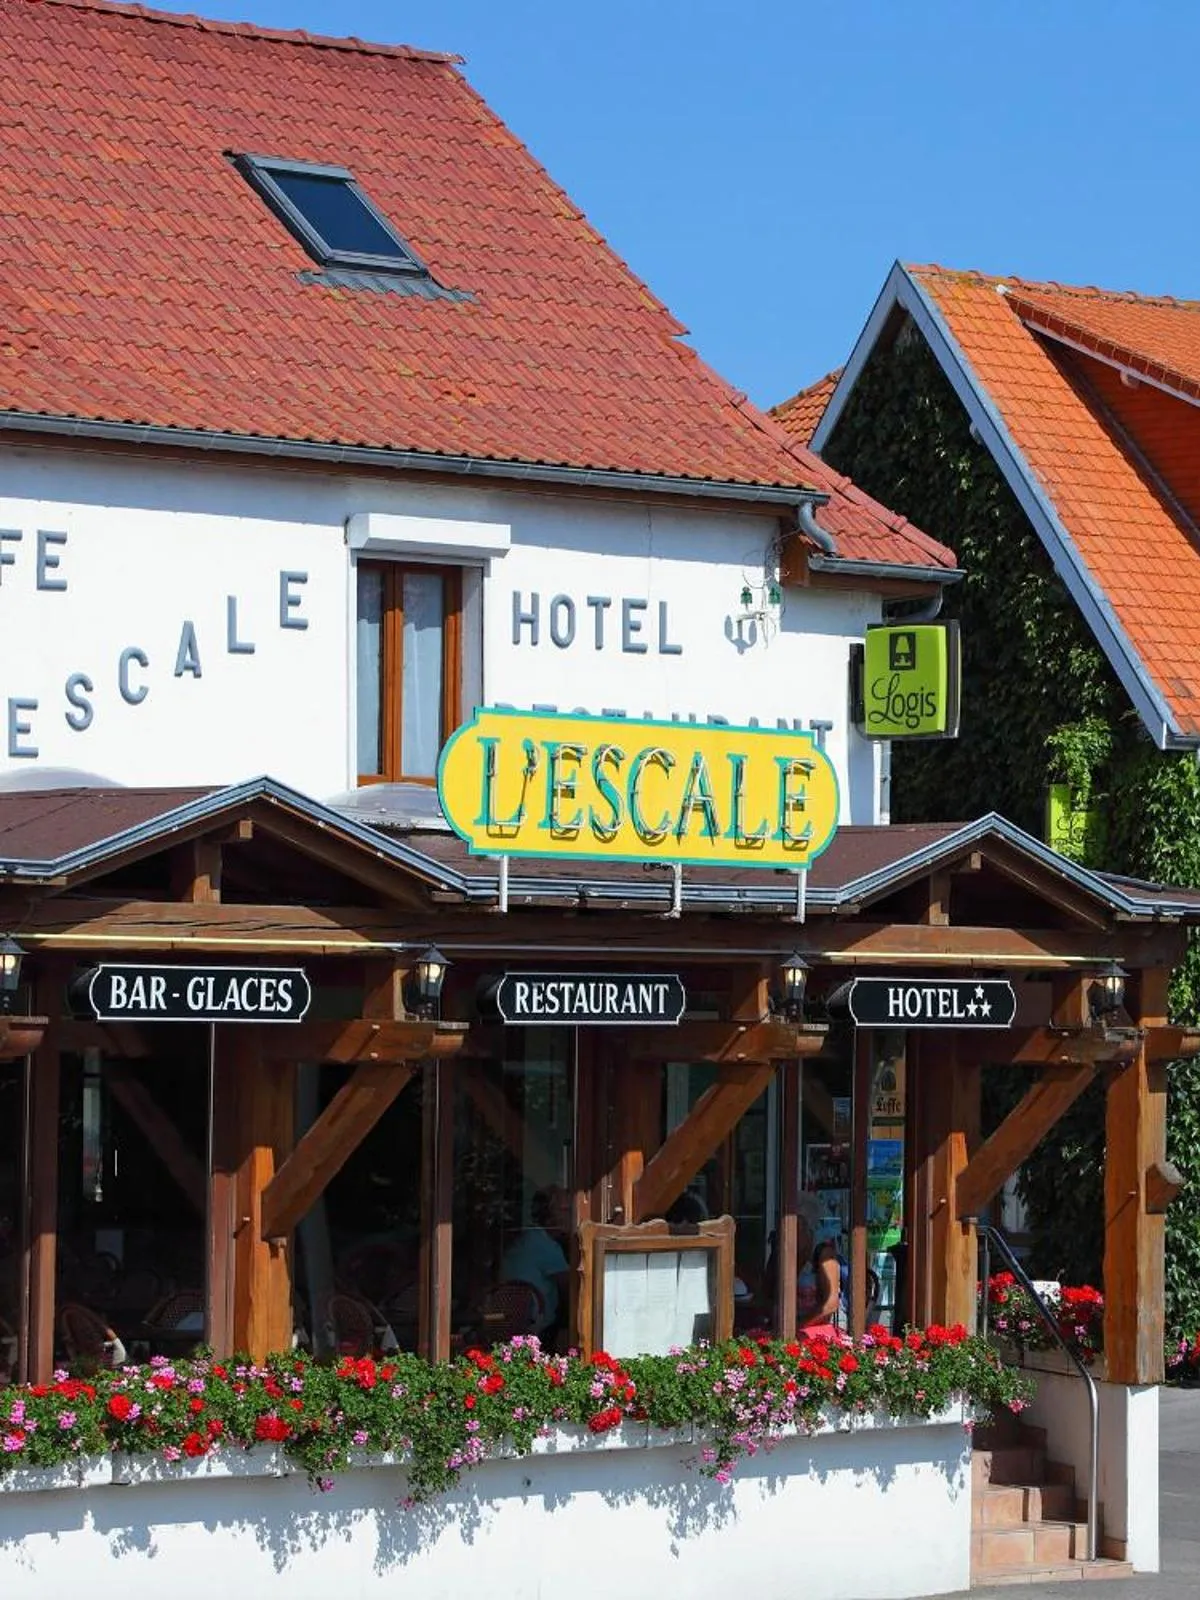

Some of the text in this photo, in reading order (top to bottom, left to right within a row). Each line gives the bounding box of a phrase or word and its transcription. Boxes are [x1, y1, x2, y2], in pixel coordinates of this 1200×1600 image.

[512, 590, 682, 656] HOTEL
[869, 673, 936, 728] Logis
[473, 737, 817, 849] L'ESCALE
[110, 975, 167, 1010] BAR
[187, 977, 292, 1012] GLACES
[515, 982, 670, 1014] RESTAURANT
[888, 987, 965, 1017] HOTEL
